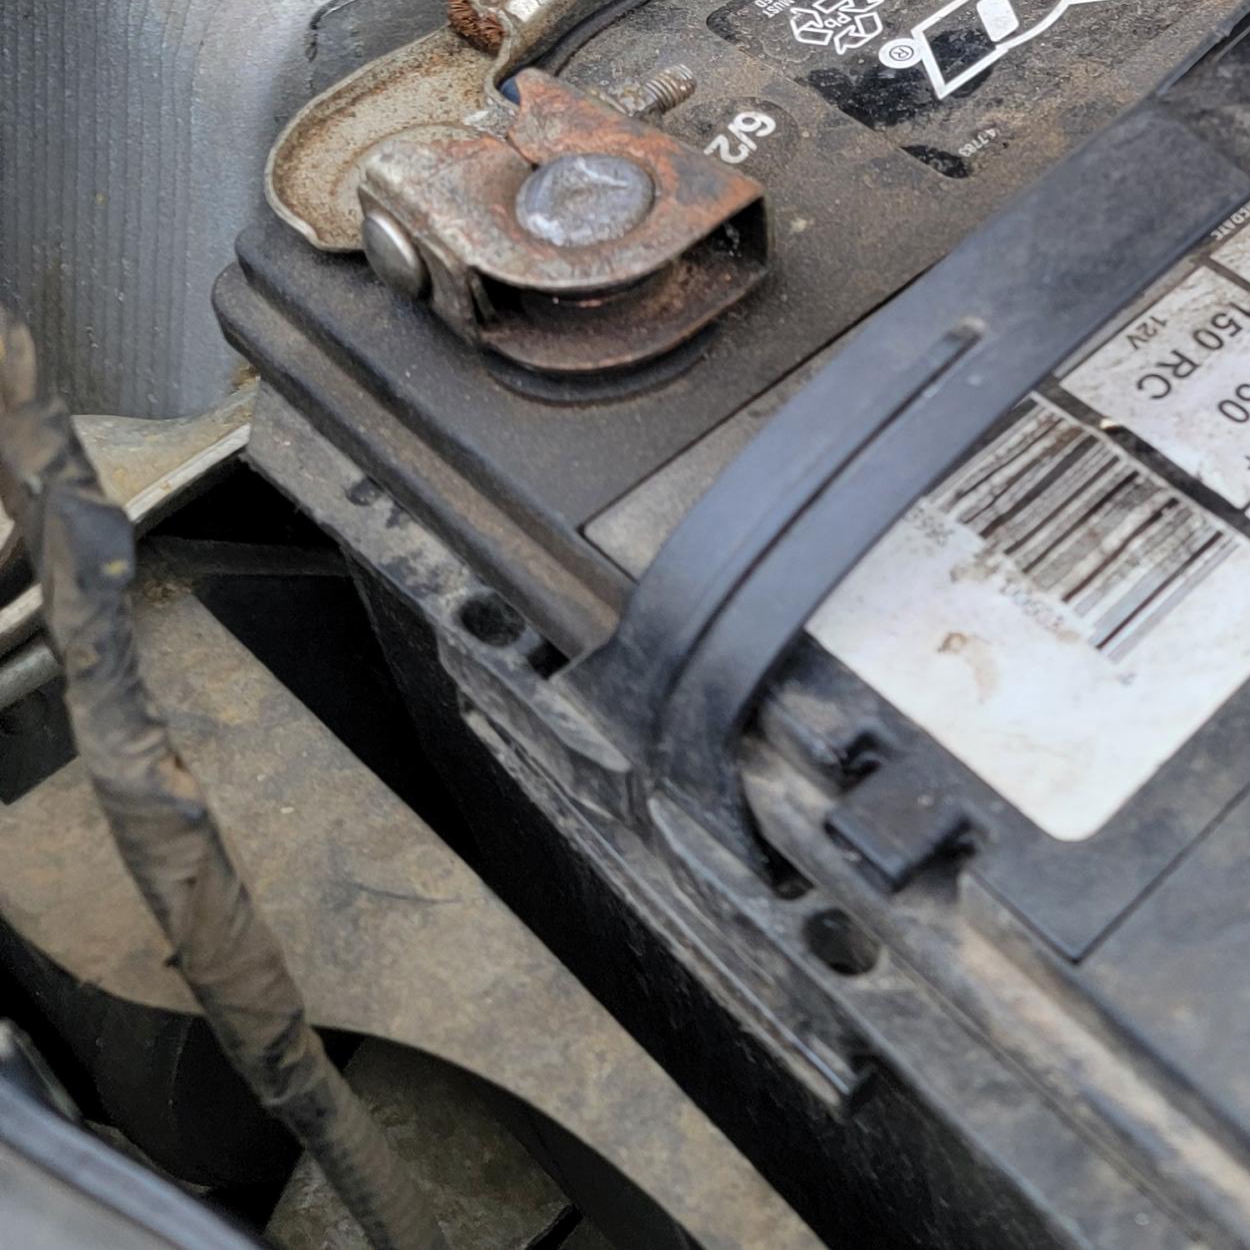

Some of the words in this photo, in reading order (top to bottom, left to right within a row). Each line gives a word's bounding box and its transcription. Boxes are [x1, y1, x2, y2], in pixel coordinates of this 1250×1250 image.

[703, 112, 775, 162] 6/2
[1126, 316, 1166, 350] 12V
[1138, 349, 1201, 398] RC
